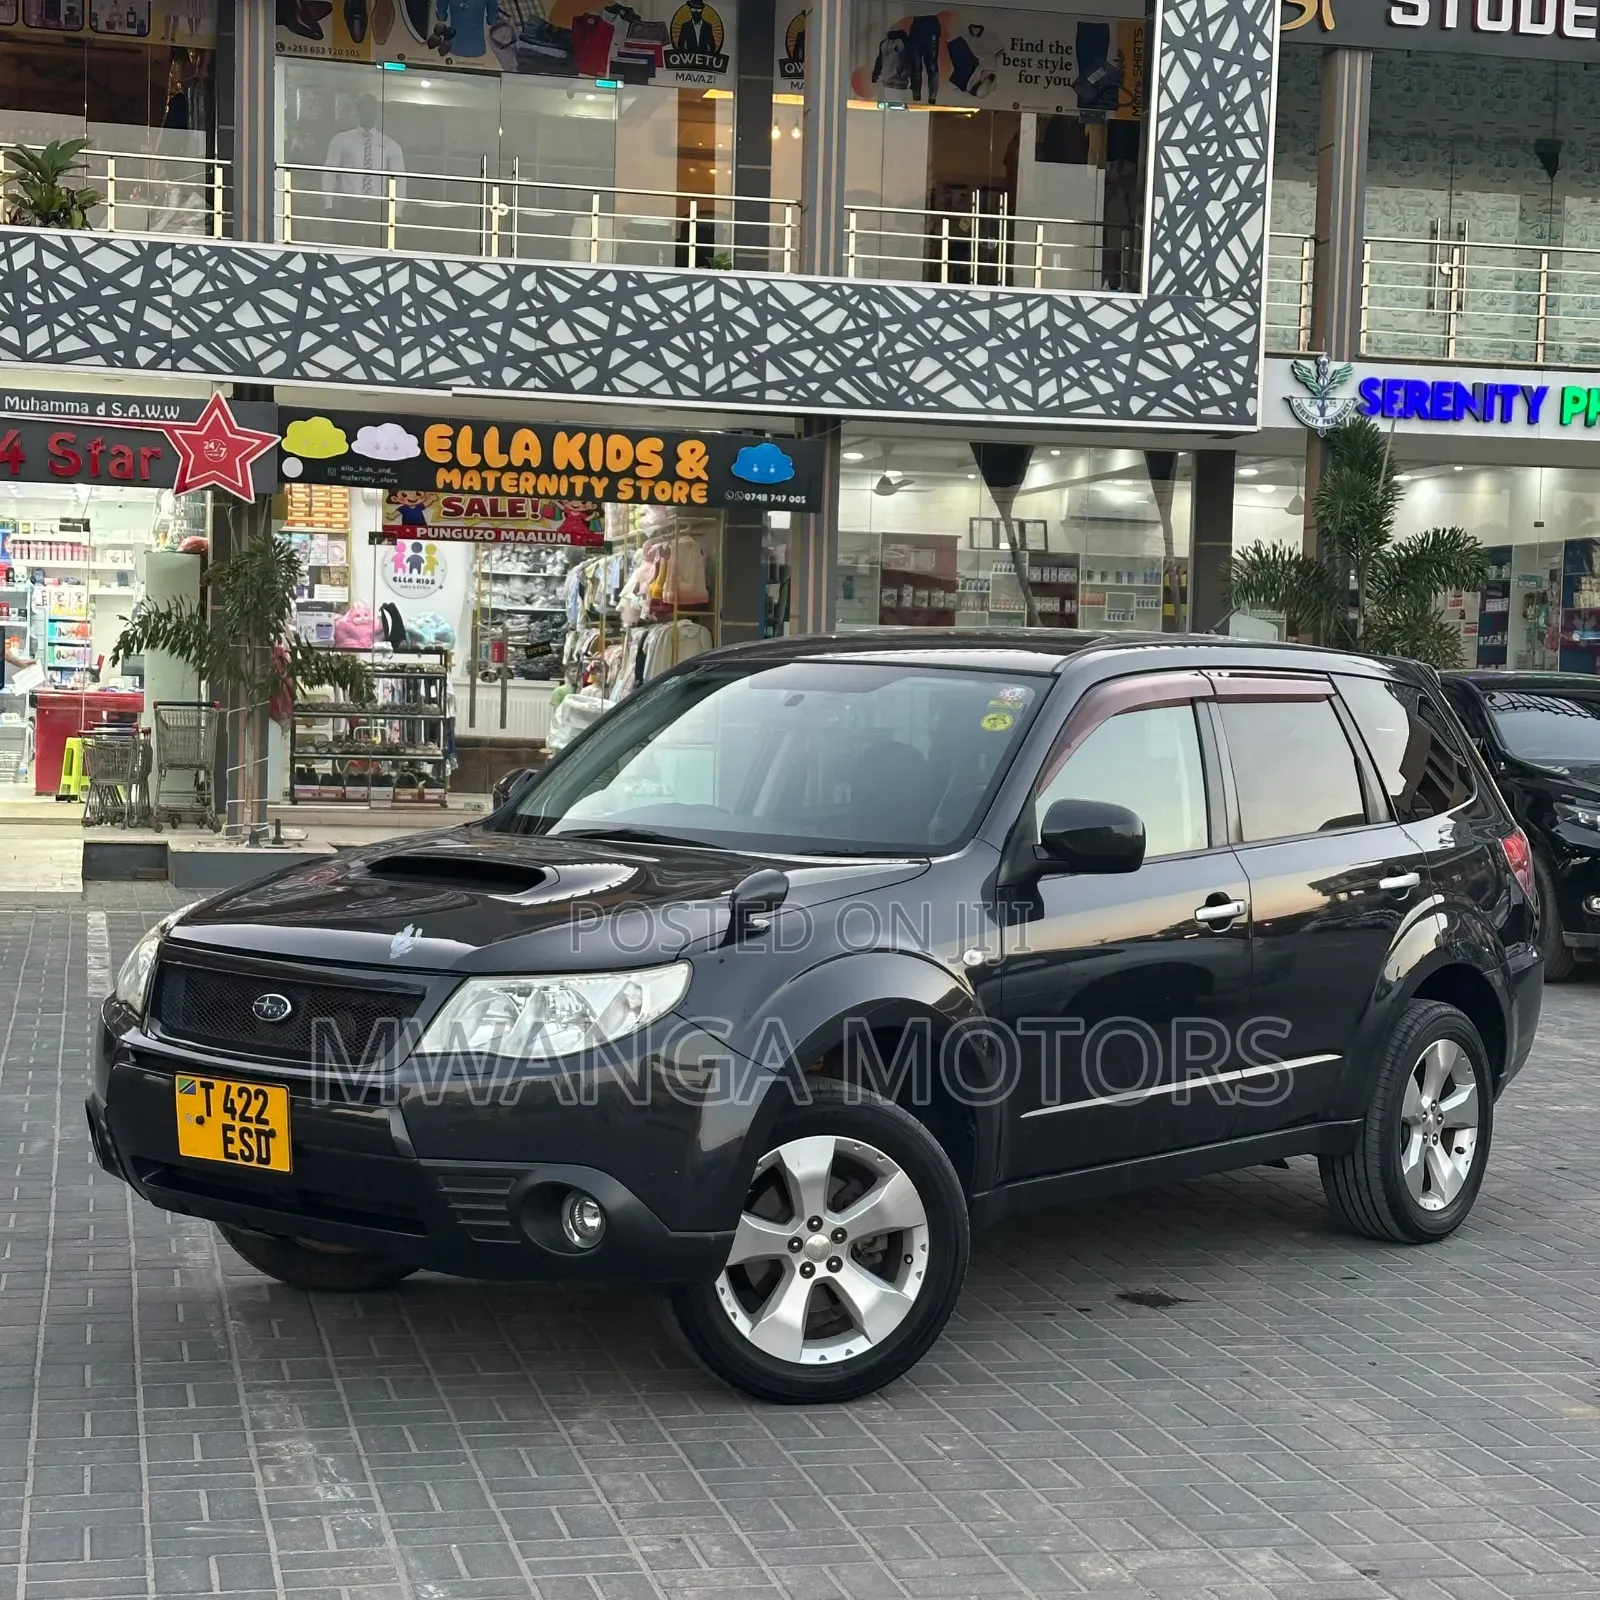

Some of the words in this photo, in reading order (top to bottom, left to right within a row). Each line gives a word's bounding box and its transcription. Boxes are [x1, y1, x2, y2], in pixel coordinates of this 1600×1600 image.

[287, 43, 308, 53] +255
[310, 43, 325, 54] 653
[328, 47, 343, 56] 120
[345, 48, 360, 57] 505
[1010, 37, 1045, 53] Find
[1048, 40, 1073, 55] the
[1132, 27, 1143, 77] SHIRTS
[669, 53, 724, 69] QWETU
[1002, 52, 1033, 68] best
[1037, 57, 1073, 73] style
[675, 72, 717, 84] MAVAZI
[1018, 69, 1041, 84] for
[4, 395, 89, 414] Muhamma
[111, 402, 180, 420] S.A.W.W
[1357, 376, 1551, 425] SERENITY
[0, 428, 26, 475] 4
[47, 431, 162, 480] Star
[424, 423, 542, 468] ELLA
[552, 431, 664, 478] KIDS
[675, 439, 709, 481] &
[436, 467, 609, 499] MATERNITY
[616, 477, 709, 504] STORE
[440, 495, 543, 521] SALE!
[744, 492, 768, 502] 0748
[770, 493, 787, 503] 747
[788, 494, 807, 504] 005
[416, 526, 497, 541] PUNGUZO
[500, 529, 572, 544] MAALUM
[392, 576, 413, 584] ELLA
[416, 577, 436, 585] KIDS
[199, 1080, 215, 1117] T
[222, 1084, 270, 1126] 422
